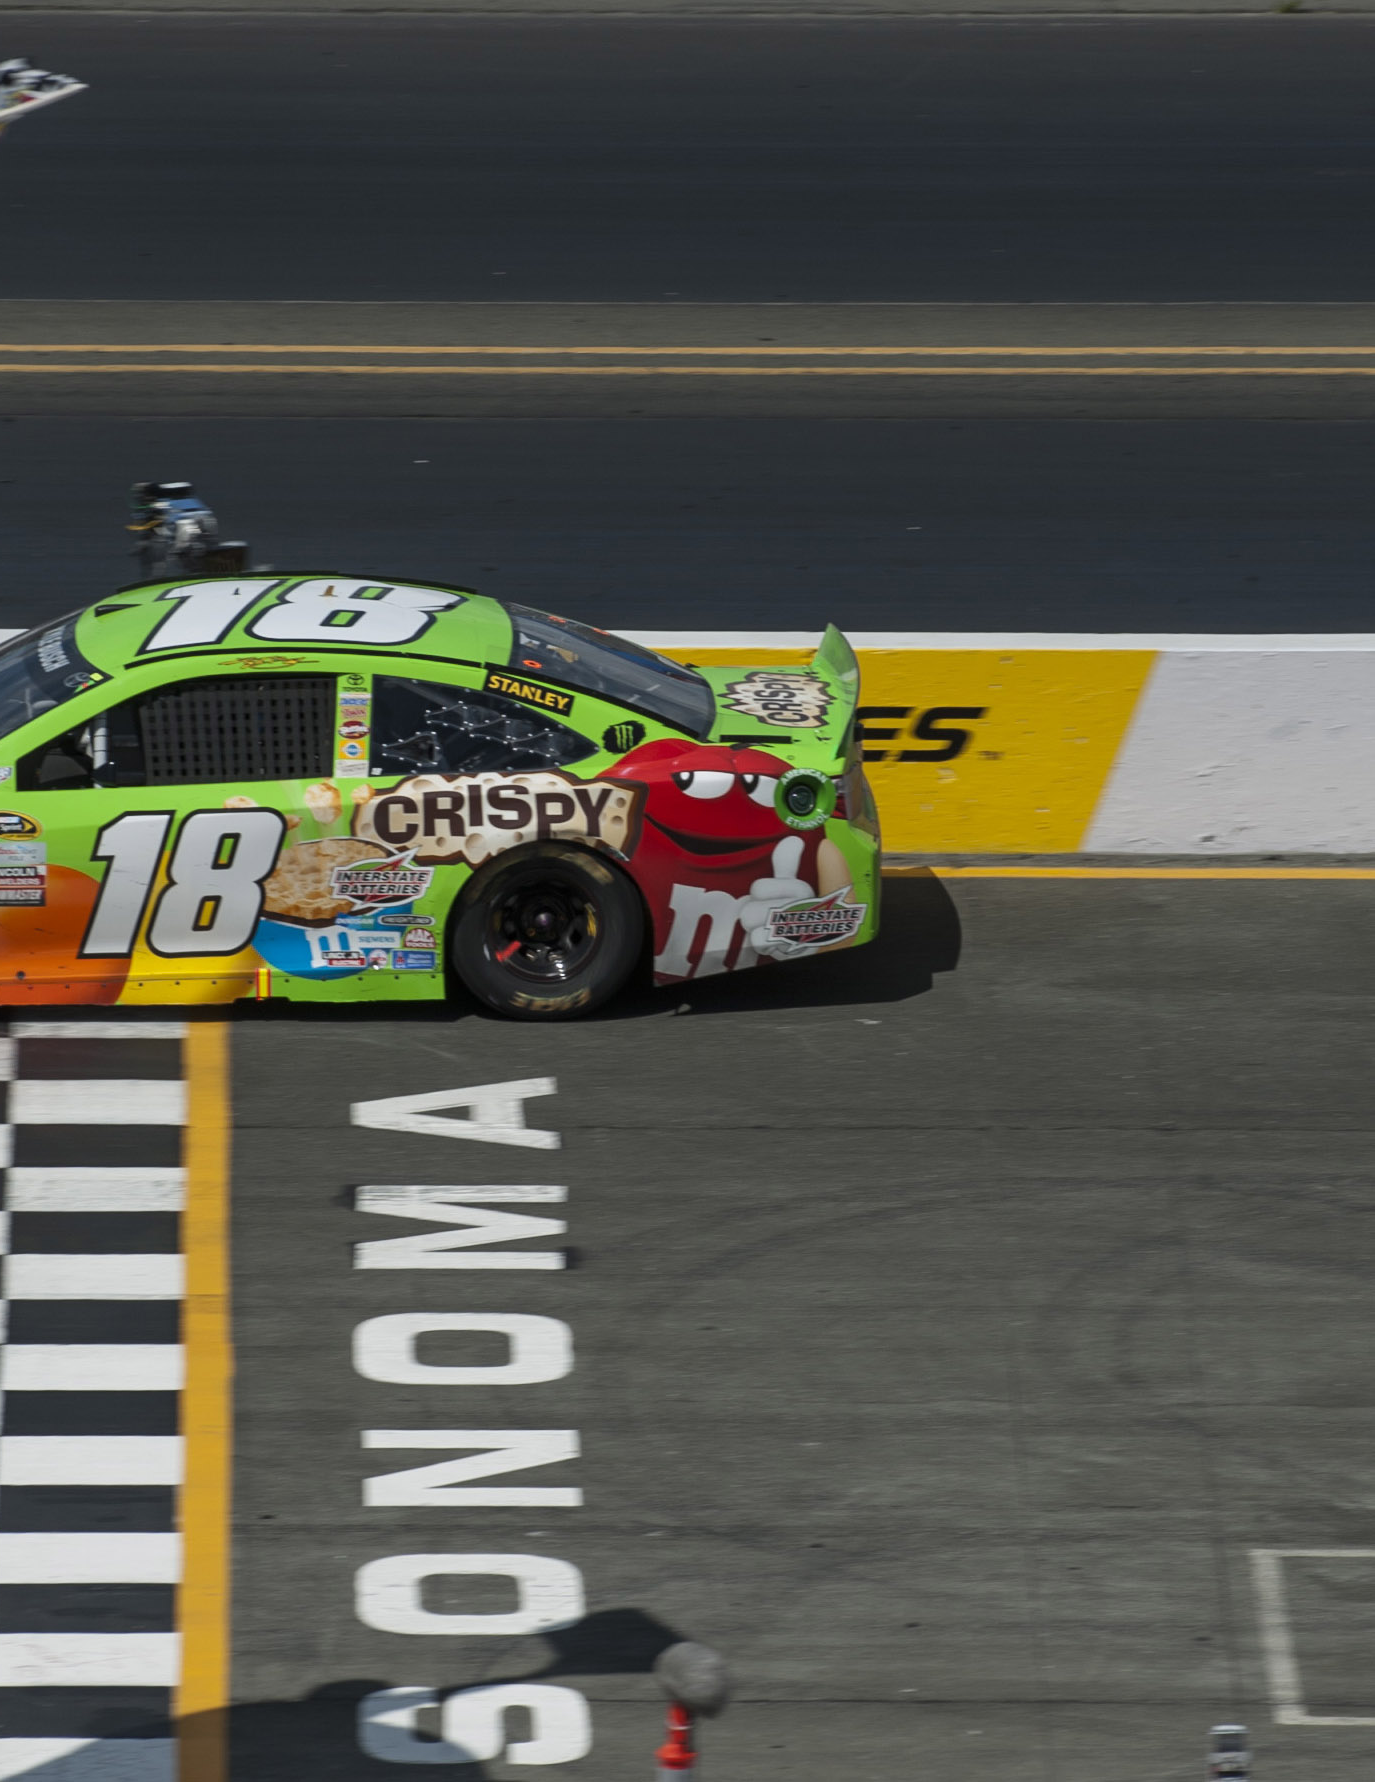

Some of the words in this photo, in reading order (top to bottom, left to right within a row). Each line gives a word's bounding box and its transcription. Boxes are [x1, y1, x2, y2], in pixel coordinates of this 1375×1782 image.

[136, 579, 470, 656] 18
[487, 675, 570, 710] STANLEY
[754, 675, 803, 723] CRISPY
[855, 706, 990, 763] ES
[781, 767, 828, 786] AMERICAN
[373, 784, 613, 844] CRISPY
[786, 812, 829, 829] ETHANOL
[77, 807, 288, 959] 18
[336, 871, 429, 882] INTERSTATE
[339, 884, 421, 894] BATTERIES
[771, 909, 860, 923] INTERSTATE
[775, 922, 856, 935] BATTERIES
[358, 935, 396, 943] SIEMENS
[350, 1076, 593, 1765] SONOMA
